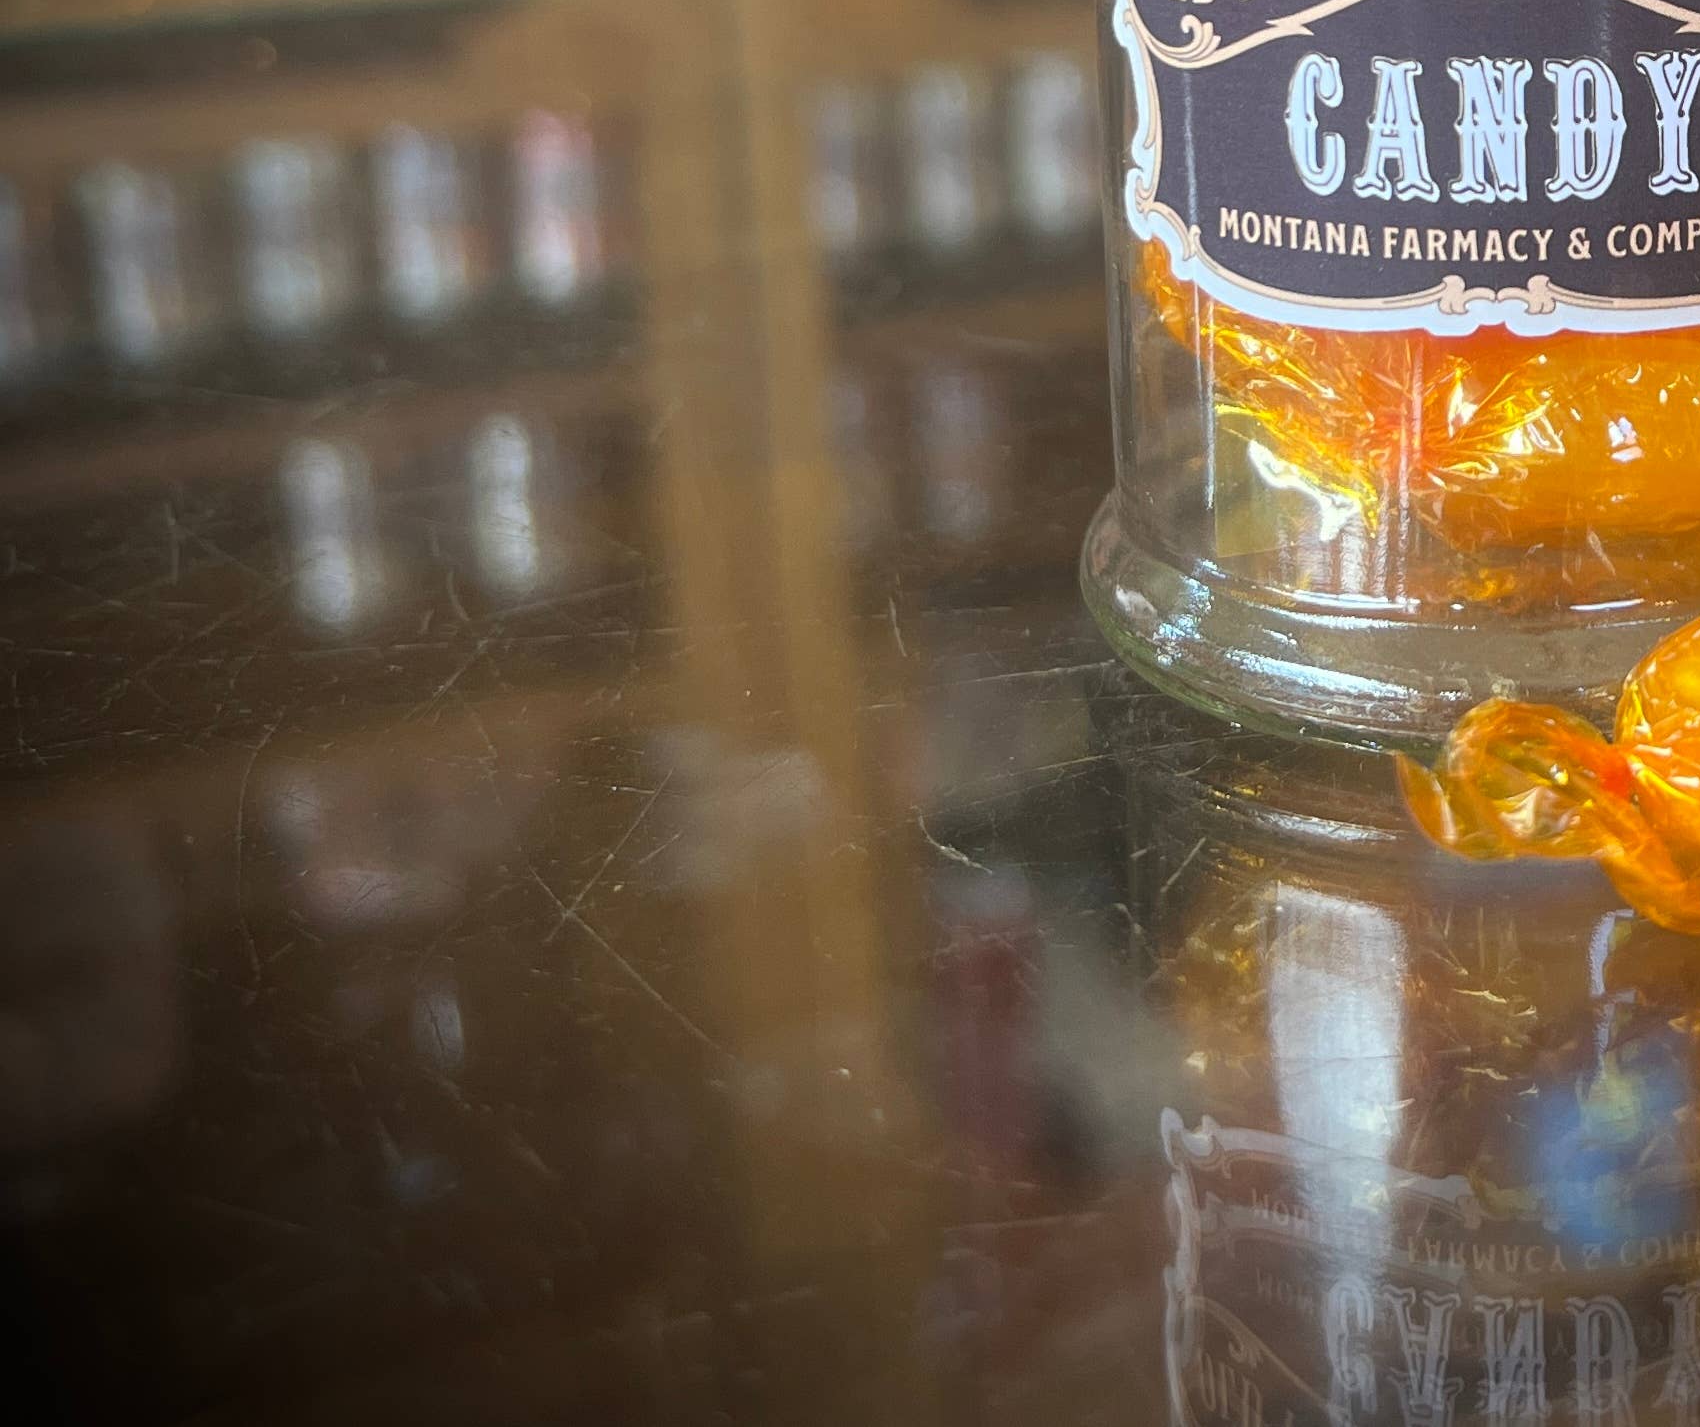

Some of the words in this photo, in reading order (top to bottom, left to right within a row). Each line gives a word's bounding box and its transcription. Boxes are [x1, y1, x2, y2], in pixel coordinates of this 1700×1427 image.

[1219, 206, 1371, 258] MONTANA
[1382, 226, 1554, 262] FARMACY
[1567, 227, 1593, 260] &
